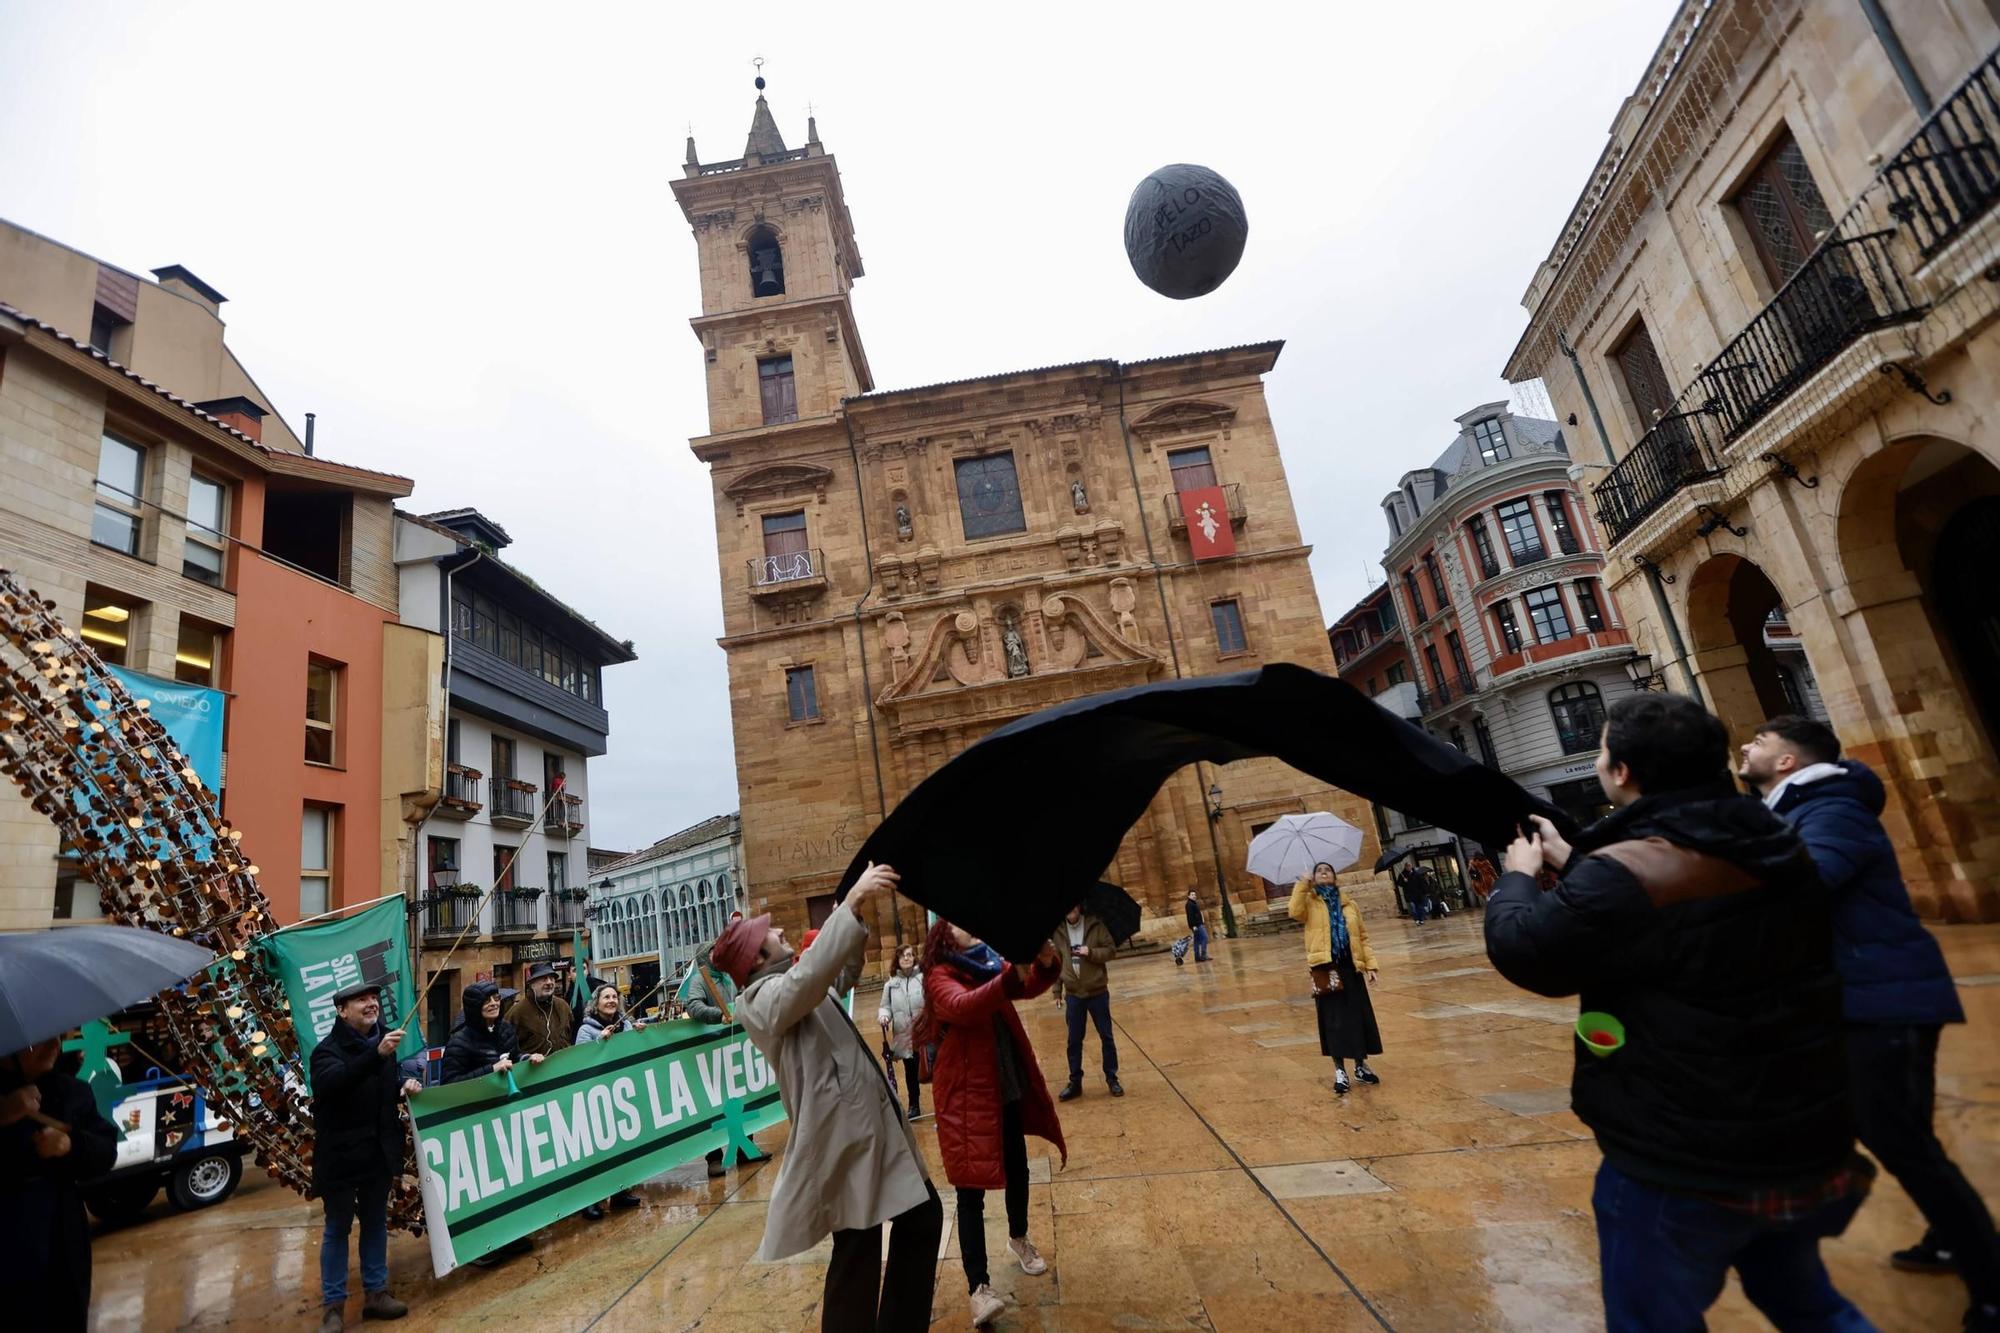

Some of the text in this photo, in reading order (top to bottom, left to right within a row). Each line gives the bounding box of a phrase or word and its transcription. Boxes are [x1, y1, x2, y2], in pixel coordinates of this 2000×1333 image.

[1154, 188, 1200, 231] PELO
[1166, 217, 1212, 253] TAZO
[154, 690, 210, 712] OVIEDO
[300, 961, 338, 1043] LA VEG
[421, 1077, 641, 1212] SALVEMOS
[645, 1060, 698, 1129] LA
